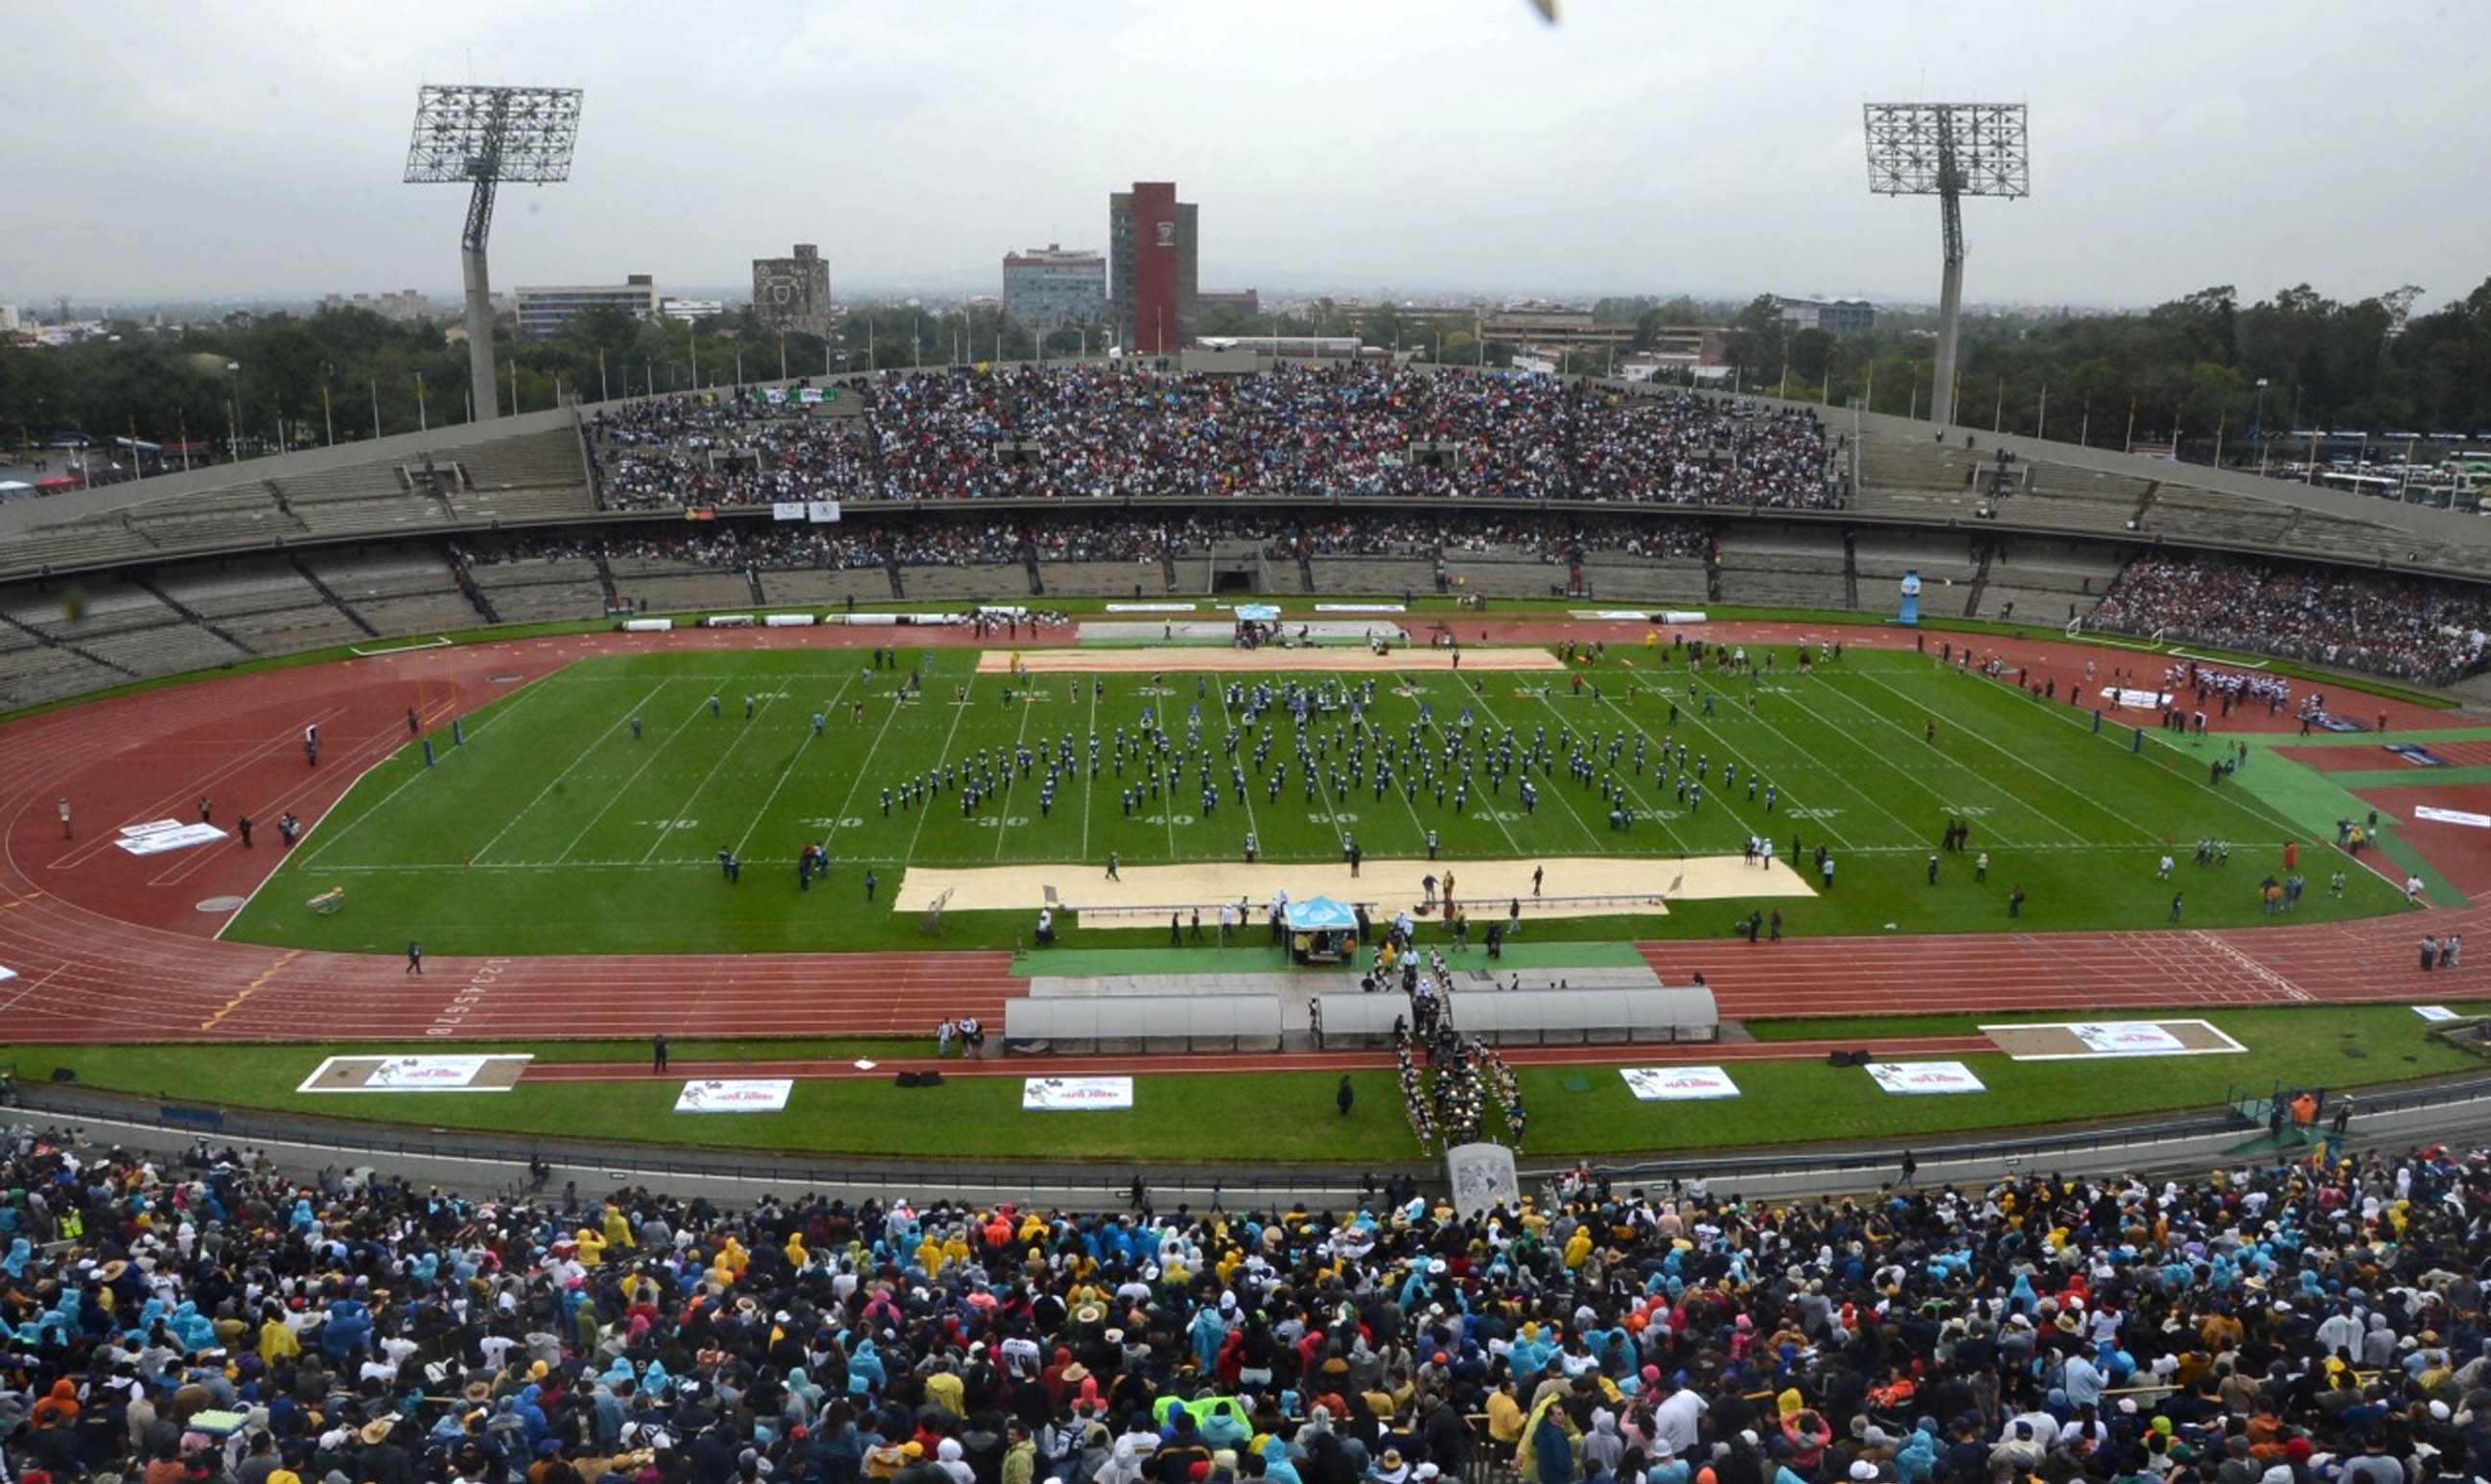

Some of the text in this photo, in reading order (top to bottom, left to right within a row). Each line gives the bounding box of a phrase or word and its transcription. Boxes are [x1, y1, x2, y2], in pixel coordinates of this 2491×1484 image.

[1145, 815, 1195, 826] 40
[1308, 813, 1358, 823] 50
[1472, 811, 1518, 821] 40
[656, 819, 699, 829] 10
[813, 818, 864, 828] 20
[979, 817, 1029, 828] 30
